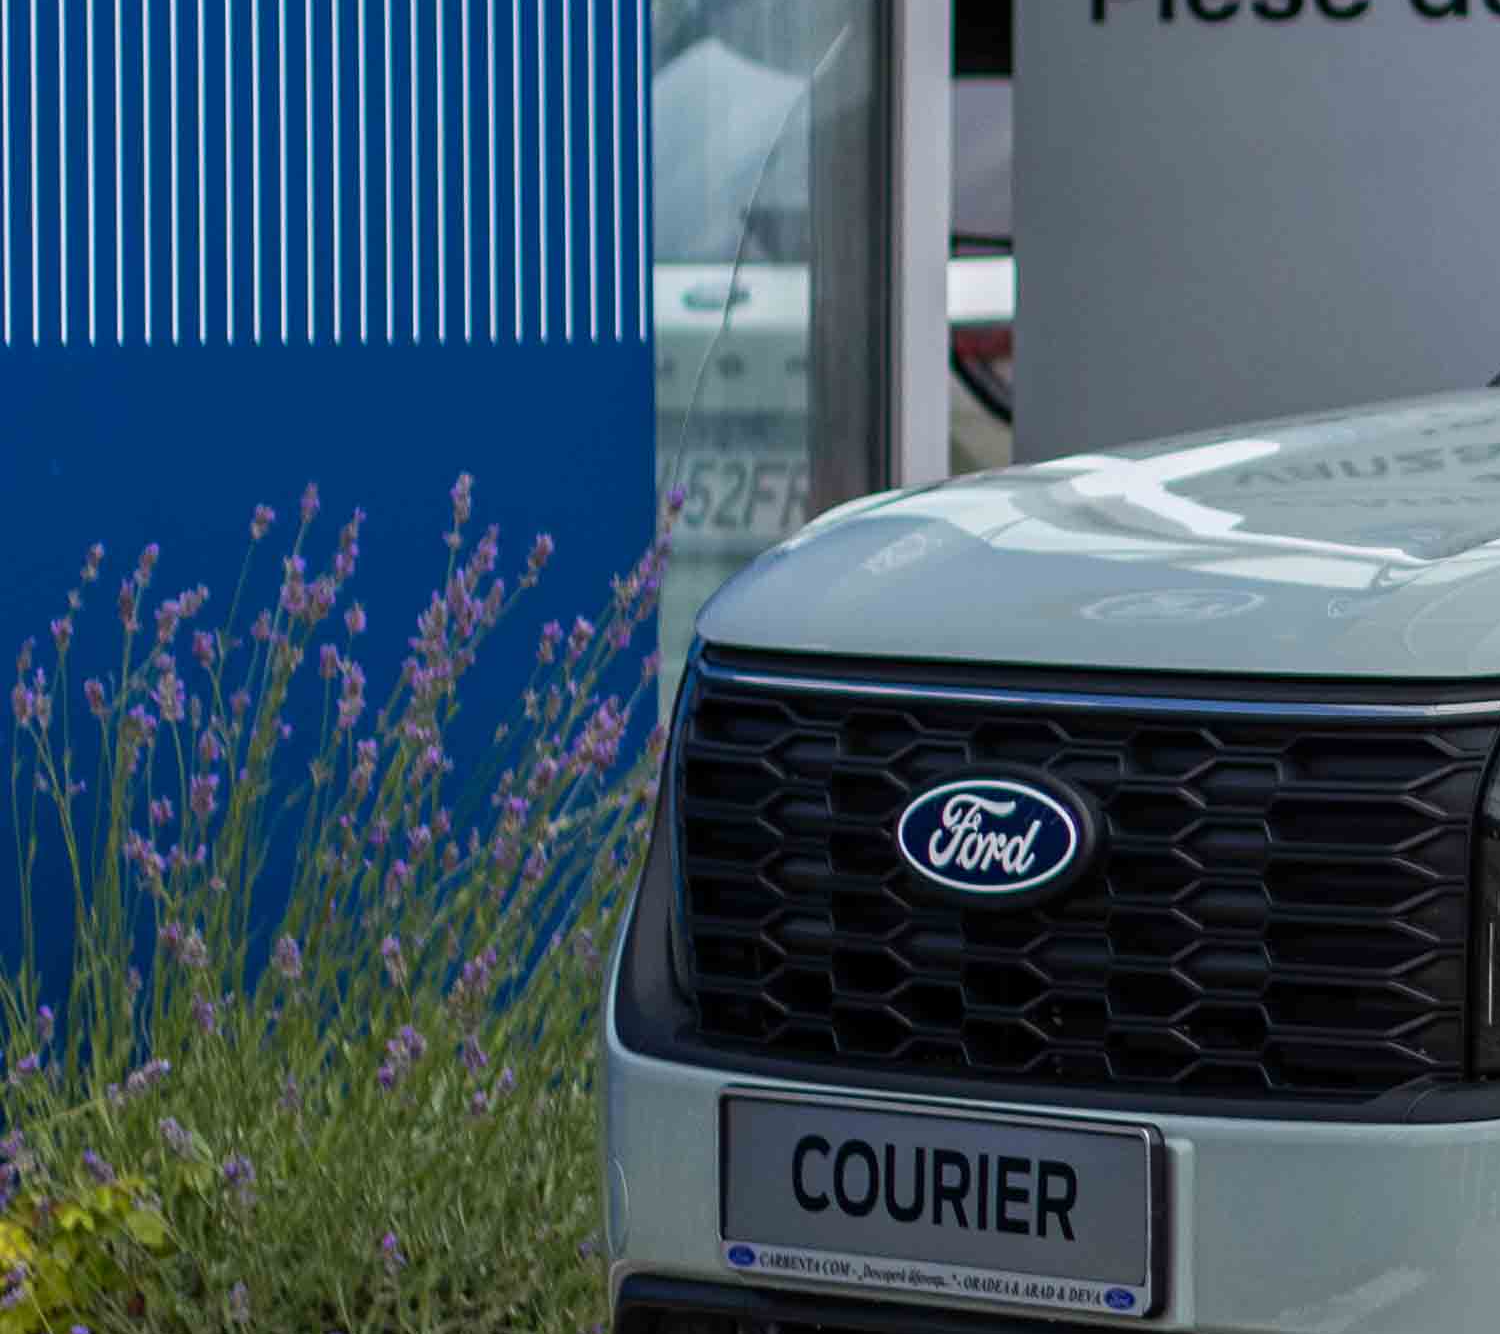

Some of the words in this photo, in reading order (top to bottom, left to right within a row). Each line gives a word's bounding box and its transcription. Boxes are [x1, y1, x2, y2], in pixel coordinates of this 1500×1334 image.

[929, 794, 1041, 875] Ford
[790, 1133, 1079, 1241] COURIER
[759, 1251, 819, 1274] CARBENTA
[822, 1257, 850, 1276] COM
[963, 1274, 1009, 1294] ORADEA
[1023, 1282, 1056, 1300] ARAD
[1068, 1288, 1102, 1306] DEVA
